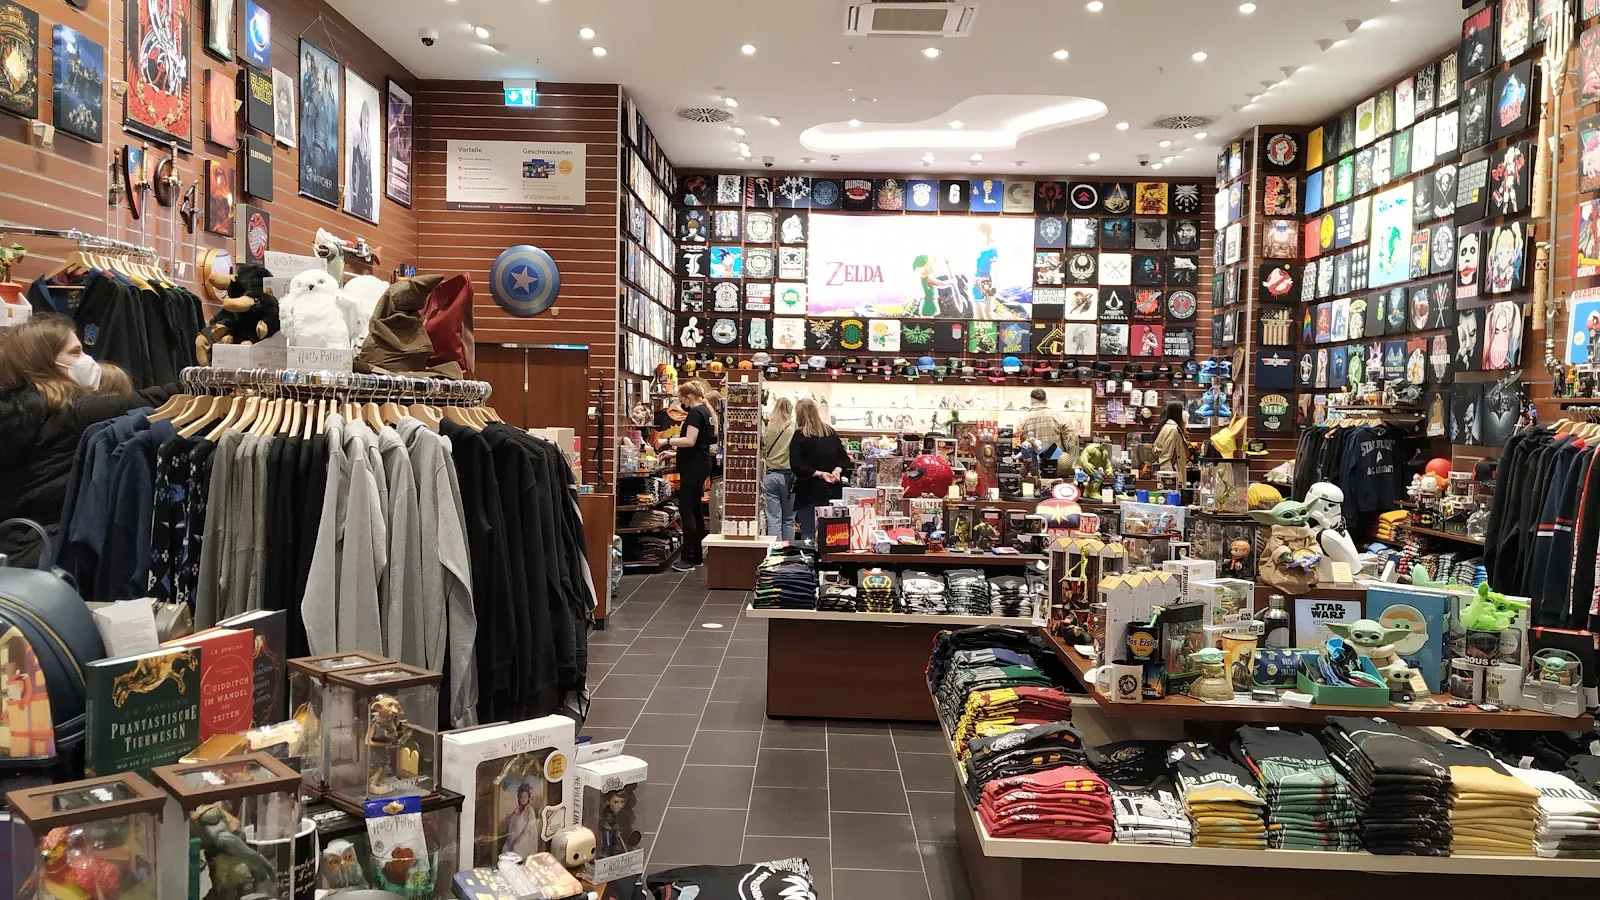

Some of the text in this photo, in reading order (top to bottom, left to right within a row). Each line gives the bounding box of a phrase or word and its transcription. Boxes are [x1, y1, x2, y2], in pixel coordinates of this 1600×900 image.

[522, 148, 573, 156] Geschenkkarten
[844, 179, 872, 191] DUNGEON
[825, 262, 884, 286] ZELDA
[298, 350, 343, 363] Harry Potter
[1264, 404, 1285, 414] PERK
[826, 523, 849, 532] MARVEL
[825, 532, 849, 544] COMICS
[1310, 603, 1346, 611] STAR
[1311, 610, 1346, 619] WARS
[203, 676, 250, 694] QUIDDITCH
[204, 689, 248, 706] IM WANDEL
[111, 704, 197, 740] PHANTASTISCHE
[212, 710, 240, 723] ZEITEN
[124, 722, 186, 752] TIERWESEN
[512, 734, 546, 752] Harry Potter
[372, 816, 417, 834] Harry Potter
